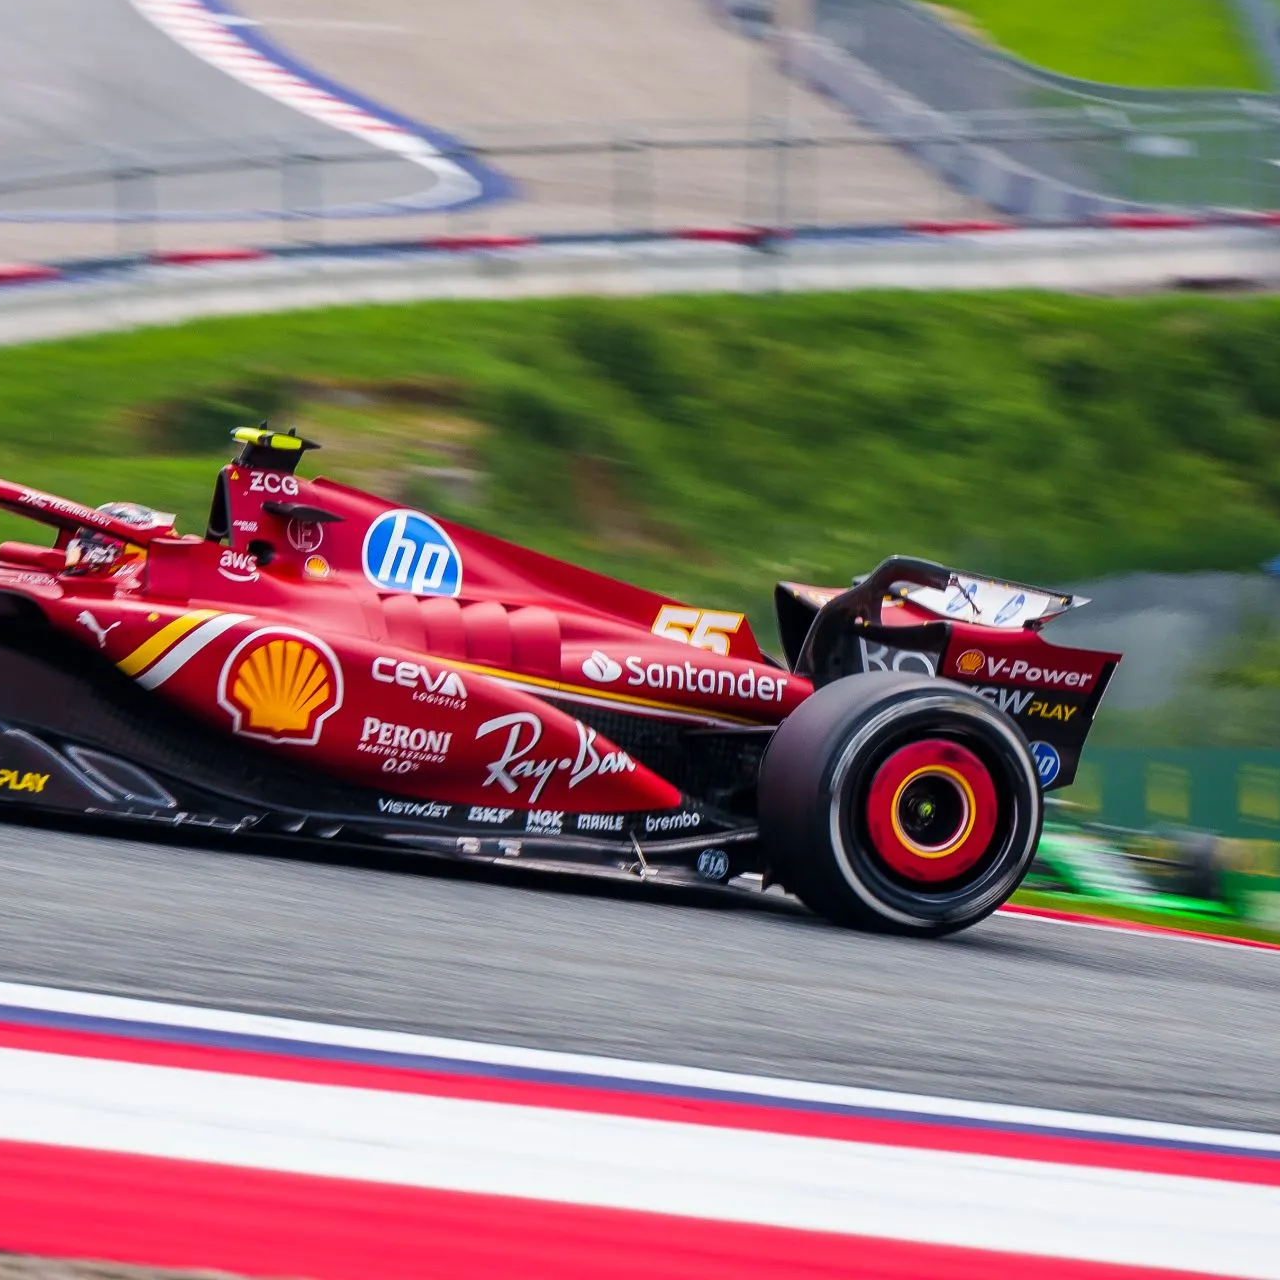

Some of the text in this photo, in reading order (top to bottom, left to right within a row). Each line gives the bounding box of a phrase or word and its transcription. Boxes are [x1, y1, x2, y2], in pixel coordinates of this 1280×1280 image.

[250, 471, 299, 496] ZCG
[48, 500, 113, 527] TECHNOLOGY
[219, 550, 259, 572] aws
[377, 513, 451, 595] hp
[651, 604, 745, 656] 55
[625, 655, 788, 702] Santander
[987, 656, 1093, 687] V-Power
[412, 691, 468, 710] LOGISTICS
[972, 685, 1077, 722] GW PLAY
[360, 716, 453, 754] PERONI
[577, 814, 625, 831] MAHLE
[645, 811, 701, 833] brembo
